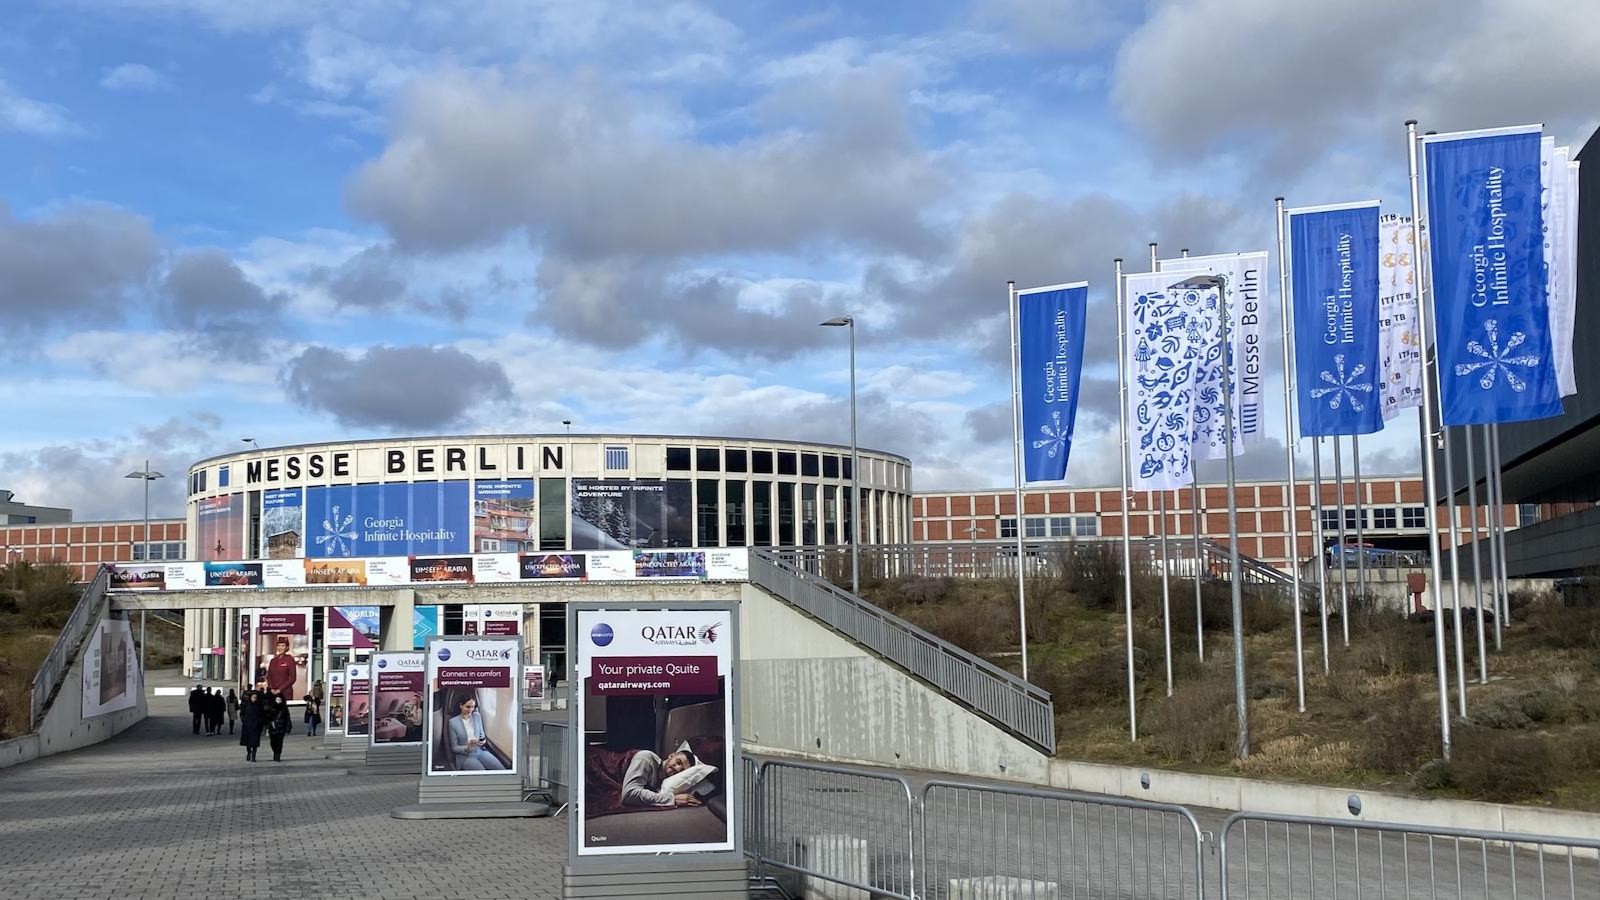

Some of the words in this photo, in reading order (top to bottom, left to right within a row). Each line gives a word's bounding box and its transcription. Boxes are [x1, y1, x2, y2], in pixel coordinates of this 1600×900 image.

[1381, 214, 1397, 222] ITB
[1484, 166, 1508, 250] Hospitality
[1337, 233, 1353, 300] Hospitality
[1469, 245, 1488, 308] Georgia
[1489, 254, 1509, 305] Infinite
[1239, 269, 1258, 325] Berlin
[1396, 293, 1411, 301] ITB
[1055, 310, 1069, 364] Hospitality
[1323, 295, 1339, 344] Georgia
[1339, 301, 1354, 343] Infinite
[1379, 319, 1391, 327] TB
[1043, 361, 1056, 403] Georgia
[1058, 365, 1069, 402] Infinite
[1244, 334, 1259, 395] Messe
[247, 453, 350, 484] MESSE
[387, 446, 563, 474] BERLIN
[364, 516, 404, 529] Georgia
[365, 530, 398, 542] Infinite
[400, 529, 456, 543] Hospitality
[642, 626, 696, 641] QATAR
[467, 650, 498, 658] QATAR
[599, 664, 622, 674] Your
[626, 664, 662, 676] private
[665, 663, 700, 676] Qsuite
[598, 681, 670, 690] qatarairways.com
